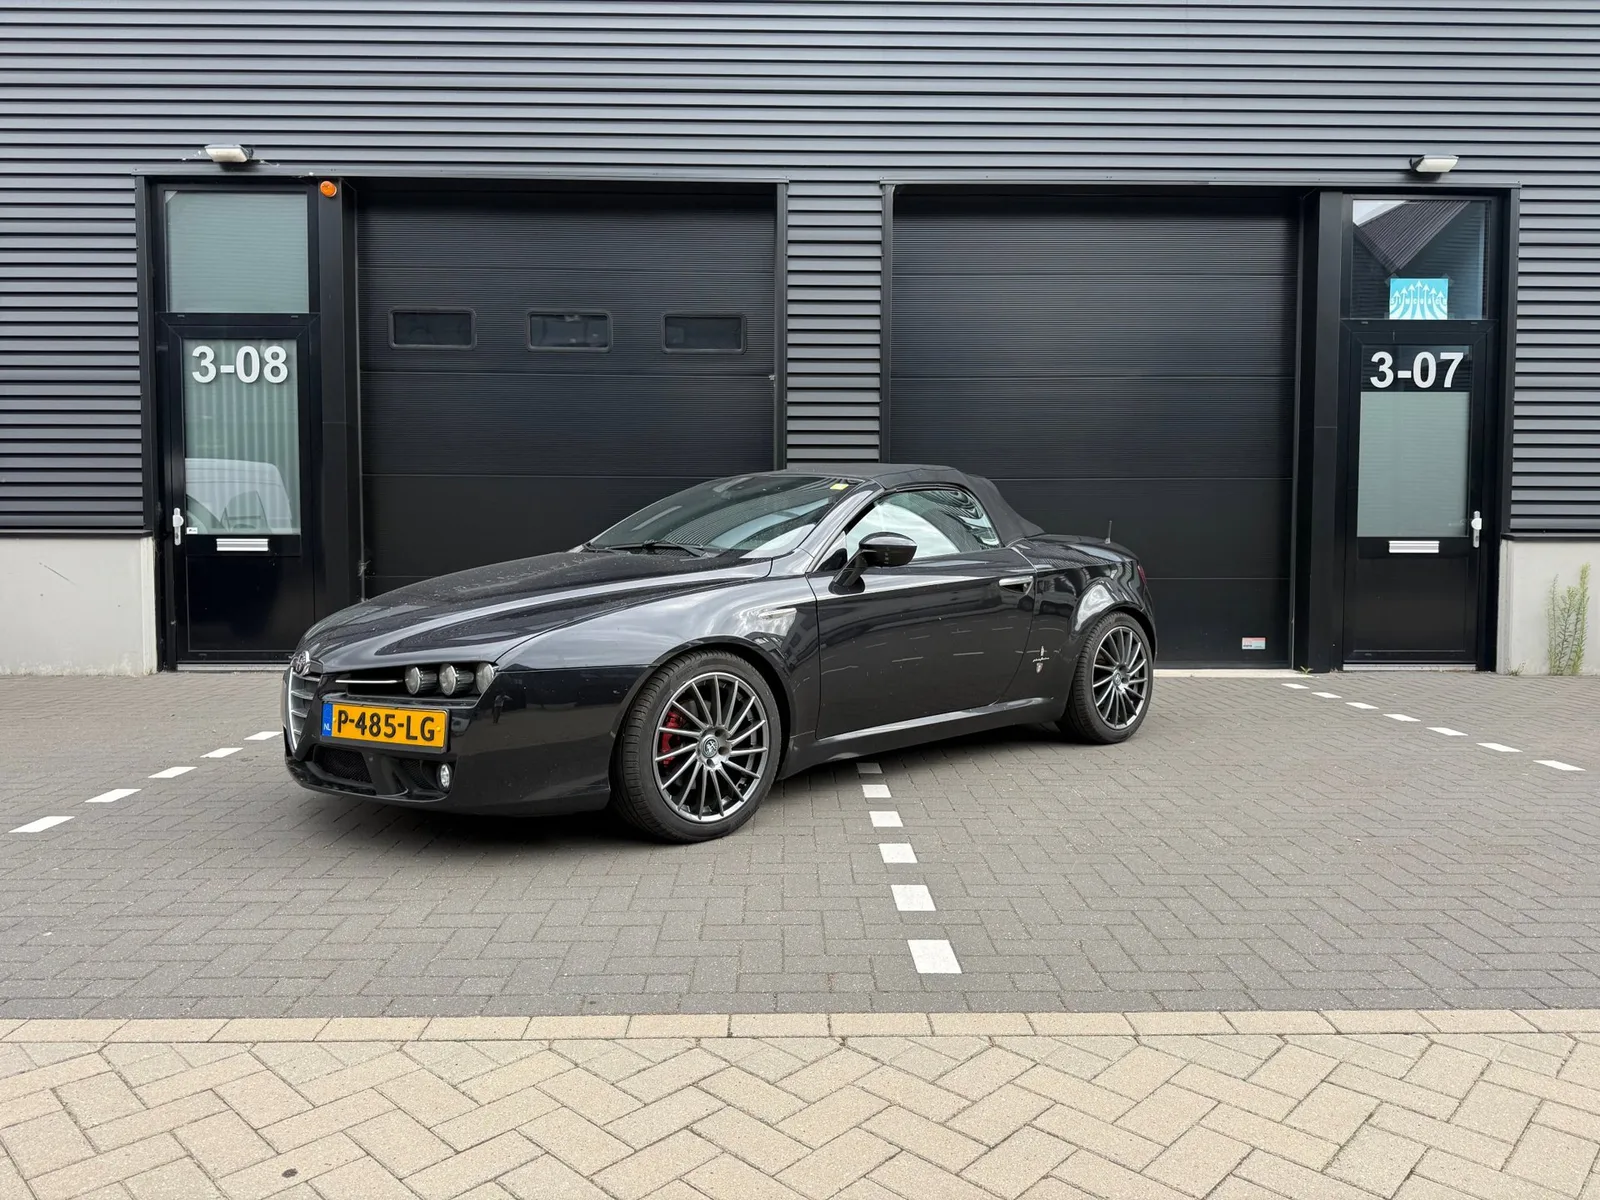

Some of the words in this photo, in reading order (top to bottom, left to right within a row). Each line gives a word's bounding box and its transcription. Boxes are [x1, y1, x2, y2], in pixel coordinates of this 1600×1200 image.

[192, 345, 288, 384] 3-08
[1370, 351, 1464, 389] 3-07
[323, 723, 331, 731] NL
[337, 709, 435, 742] P-485-LG
